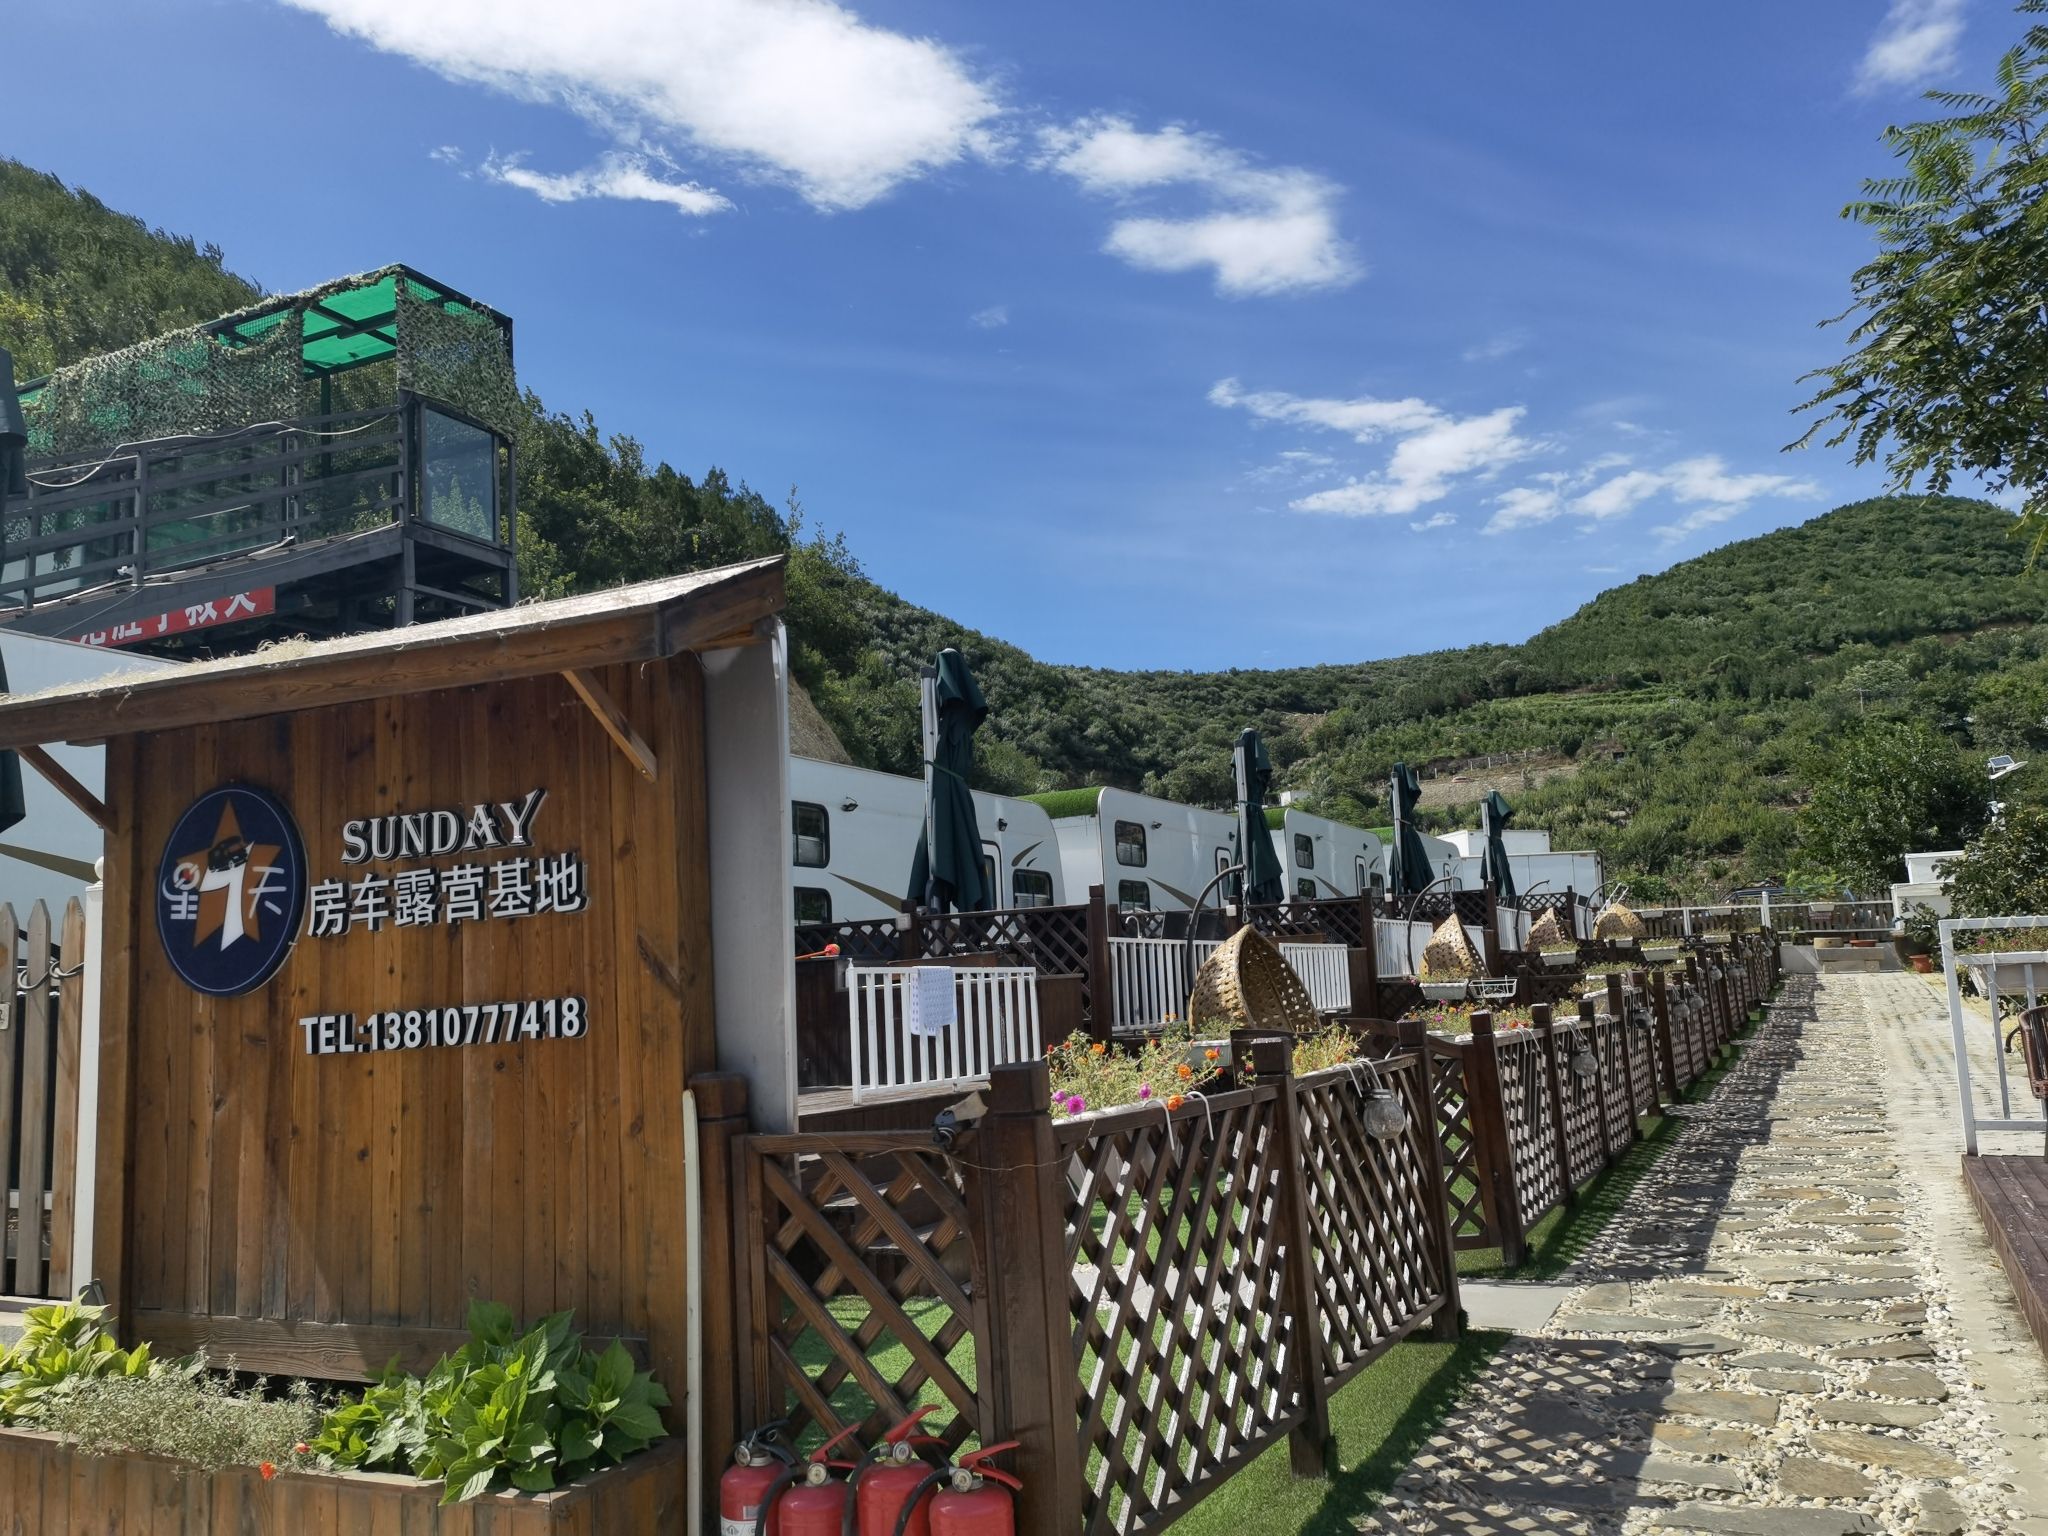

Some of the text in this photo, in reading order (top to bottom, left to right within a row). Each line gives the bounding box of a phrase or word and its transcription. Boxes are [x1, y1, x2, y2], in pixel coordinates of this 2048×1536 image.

[340, 788, 547, 864] SUNDAY
[307, 852, 585, 937] 房车露营基地
[300, 997, 586, 1055] TEL:13810777418
